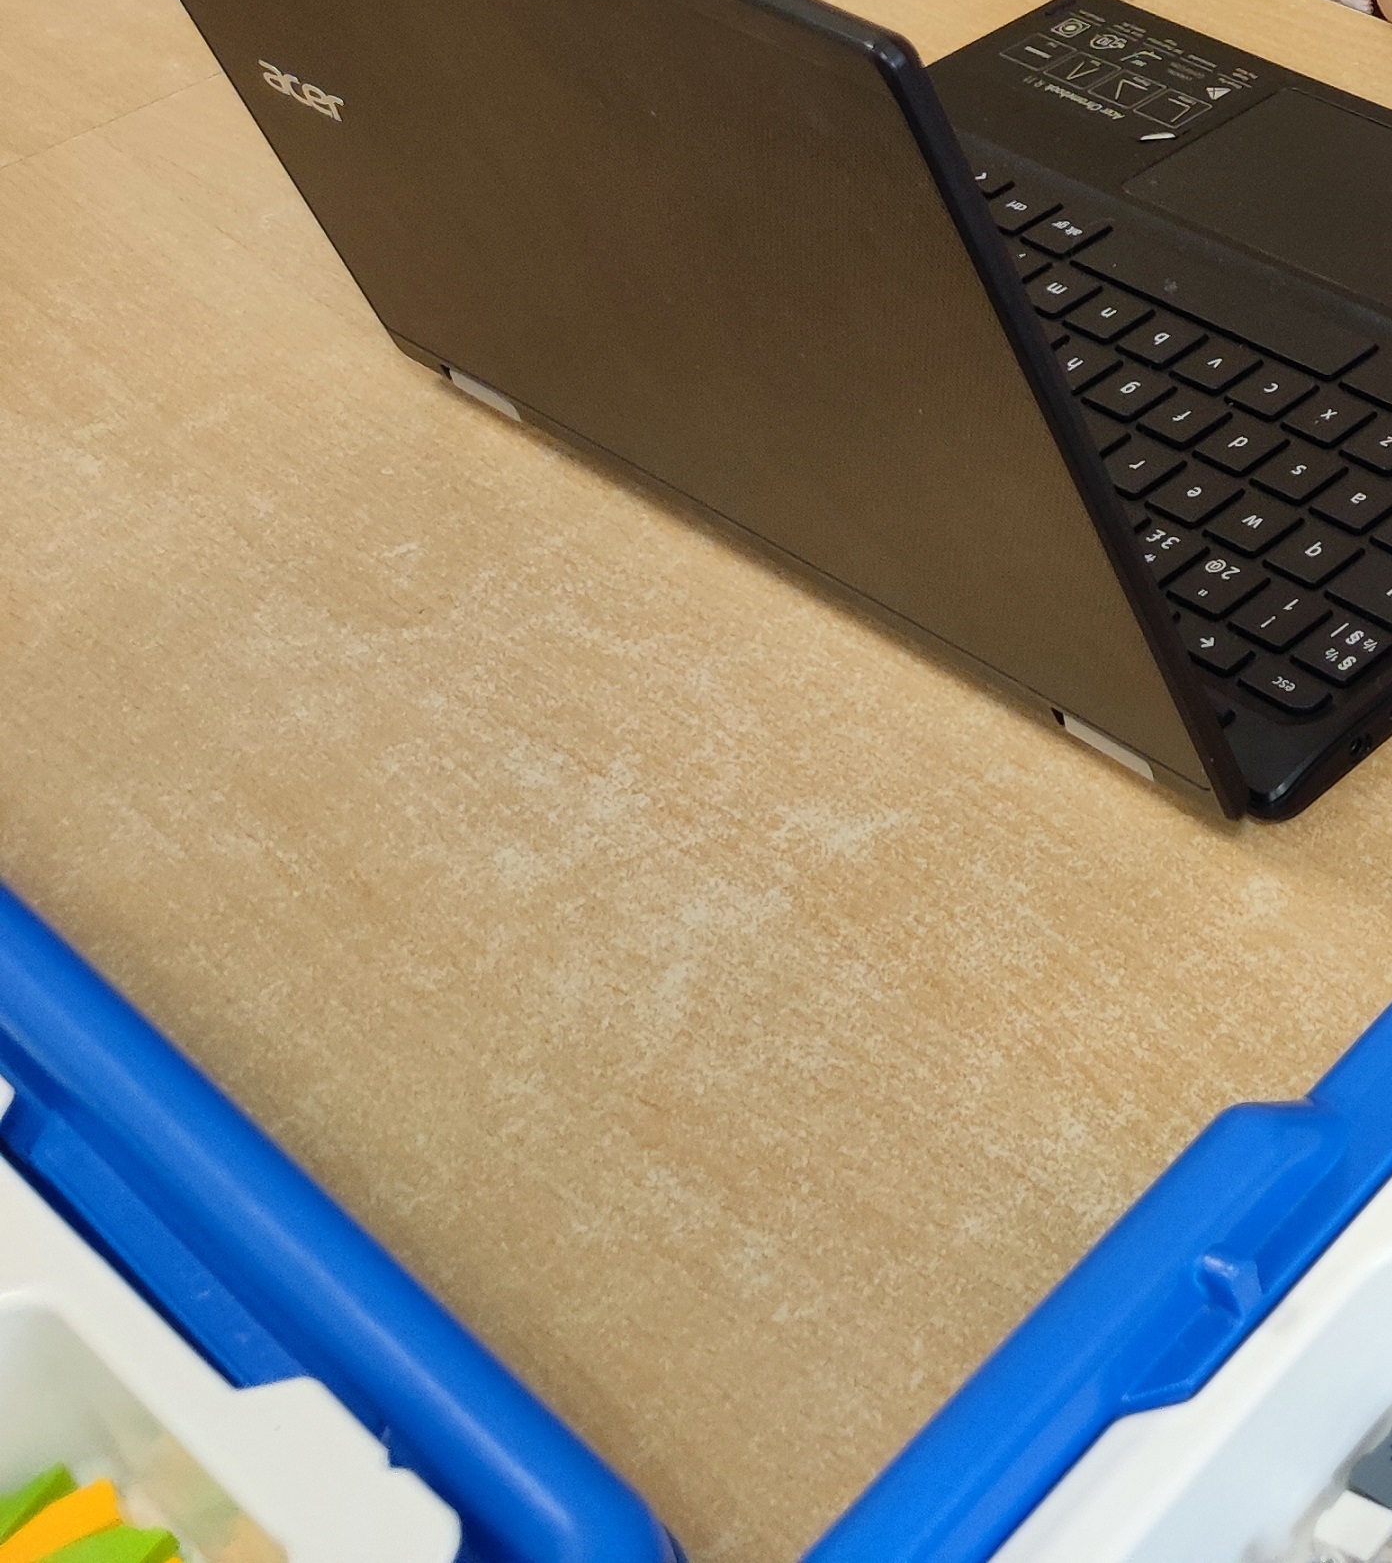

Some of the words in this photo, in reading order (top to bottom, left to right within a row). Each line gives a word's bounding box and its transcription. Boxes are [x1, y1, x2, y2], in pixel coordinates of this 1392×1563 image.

[258, 59, 345, 122] acer
[1046, 282, 1068, 295] m
[1100, 307, 1117, 318] n
[1154, 332, 1170, 345] b
[1067, 357, 1084, 371] h
[1207, 358, 1223, 369] v
[1119, 381, 1141, 394] g
[1263, 382, 1279, 393] c
[1172, 410, 1192, 422] f
[1320, 408, 1338, 420] x
[1227, 436, 1249, 448] d
[1128, 460, 1146, 470] r
[1290, 464, 1308, 475] s
[1186, 486, 1202, 498] e
[1350, 492, 1367, 504] a
[1241, 514, 1264, 529] w
[1304, 541, 1322, 557] q
[1271, 676, 1296, 692] esc
